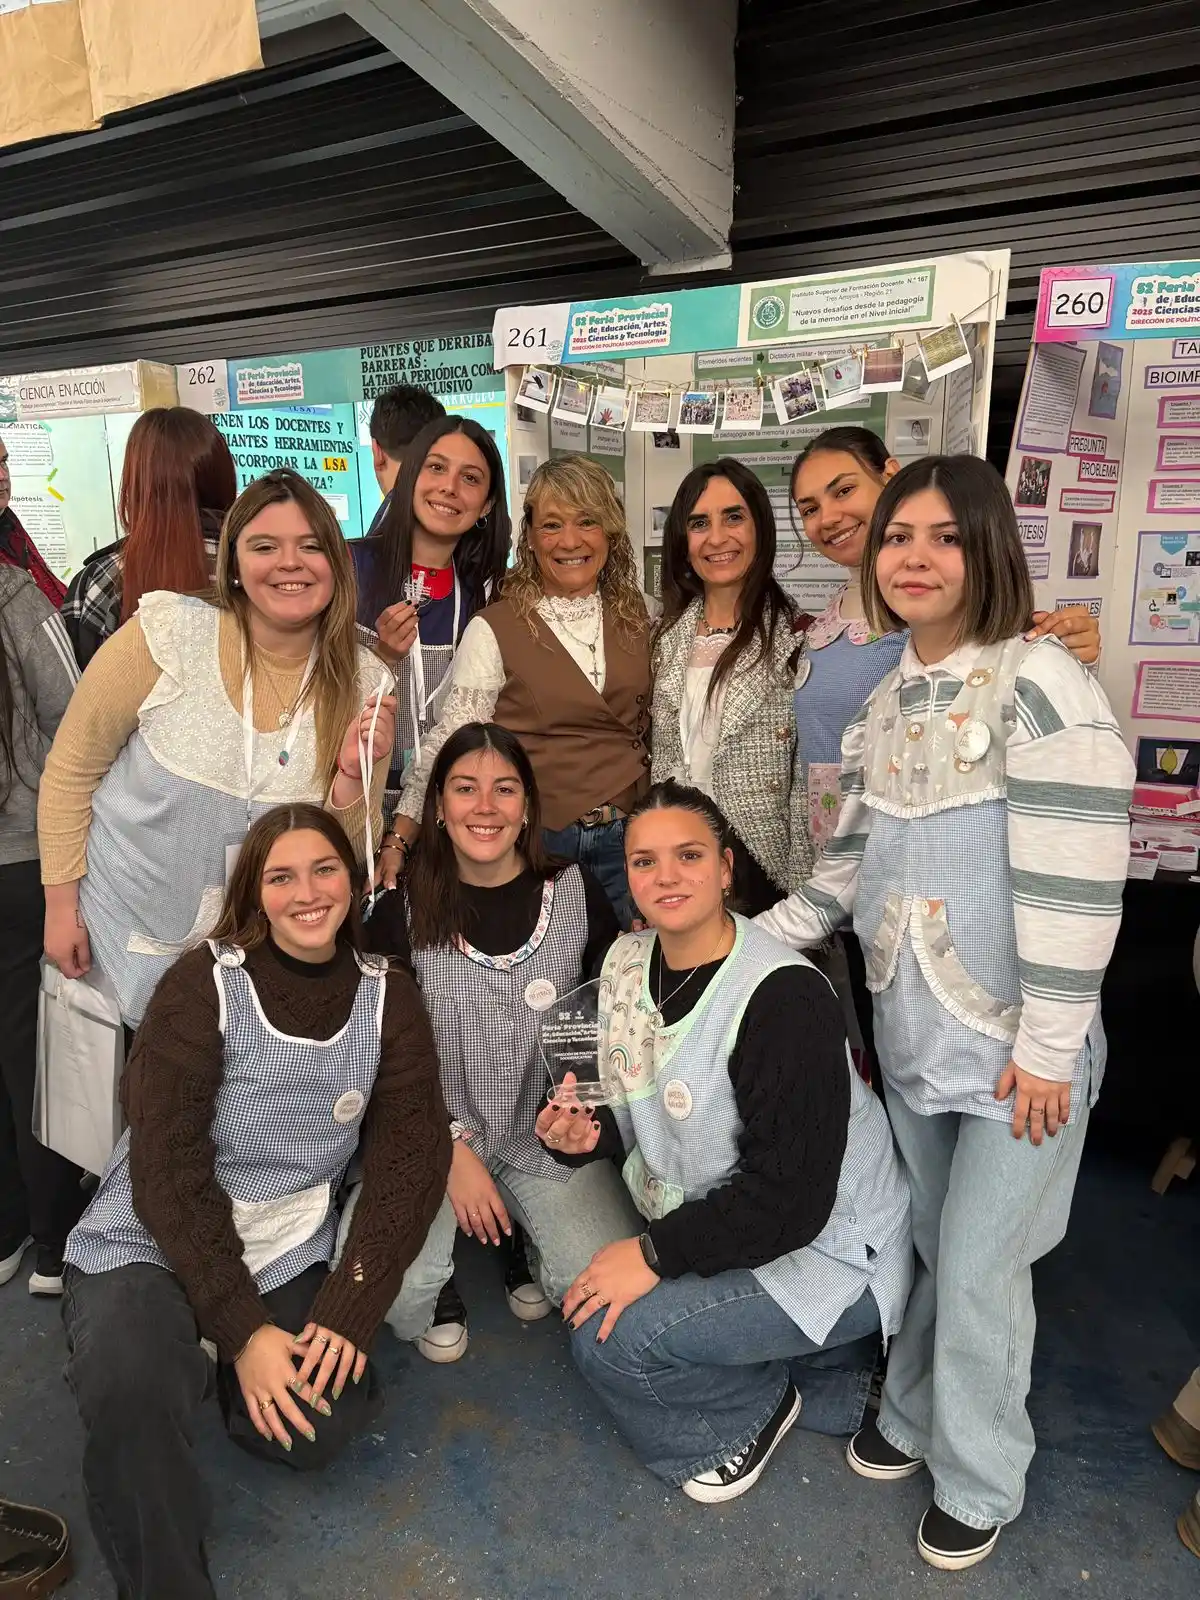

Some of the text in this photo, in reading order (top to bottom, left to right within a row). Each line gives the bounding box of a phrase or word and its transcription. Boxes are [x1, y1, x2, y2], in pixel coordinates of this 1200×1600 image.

[815, 287, 840, 296] Superior
[848, 282, 880, 292] Formación
[880, 279, 905, 288] Docente
[1157, 281, 1196, 293] Feria
[854, 301, 877, 310] desde
[886, 295, 925, 307] pedagogía
[1055, 291, 1104, 315] 260
[1156, 295, 1170, 304] de
[589, 314, 615, 325] Feria
[618, 307, 669, 323] Provincial
[810, 316, 817, 324] la
[817, 314, 849, 323] memoria
[868, 308, 888, 318] Nivel
[1132, 305, 1200, 316] 2025 Ciencias
[1130, 317, 1165, 325] DIRECCIÓN
[507, 327, 547, 348] 261
[588, 332, 619, 342] Ciencias
[626, 327, 667, 339] Tecnología
[360, 342, 410, 360] PUENTES
[413, 339, 435, 357] QUE
[188, 365, 216, 385] 262
[410, 361, 468, 384] PERIÓDICA
[20, 378, 106, 400] CIENCIA EN ACCIÓN
[248, 415, 270, 430] LOS
[275, 417, 331, 434] DOCENTES
[337, 422, 344, 435] Y
[275, 436, 353, 454] HERRAMIENTAS
[1070, 436, 1105, 454] PREGUNTA
[304, 456, 317, 470] LA
[324, 458, 347, 472] LSA
[1081, 462, 1118, 478] PROBLEMA
